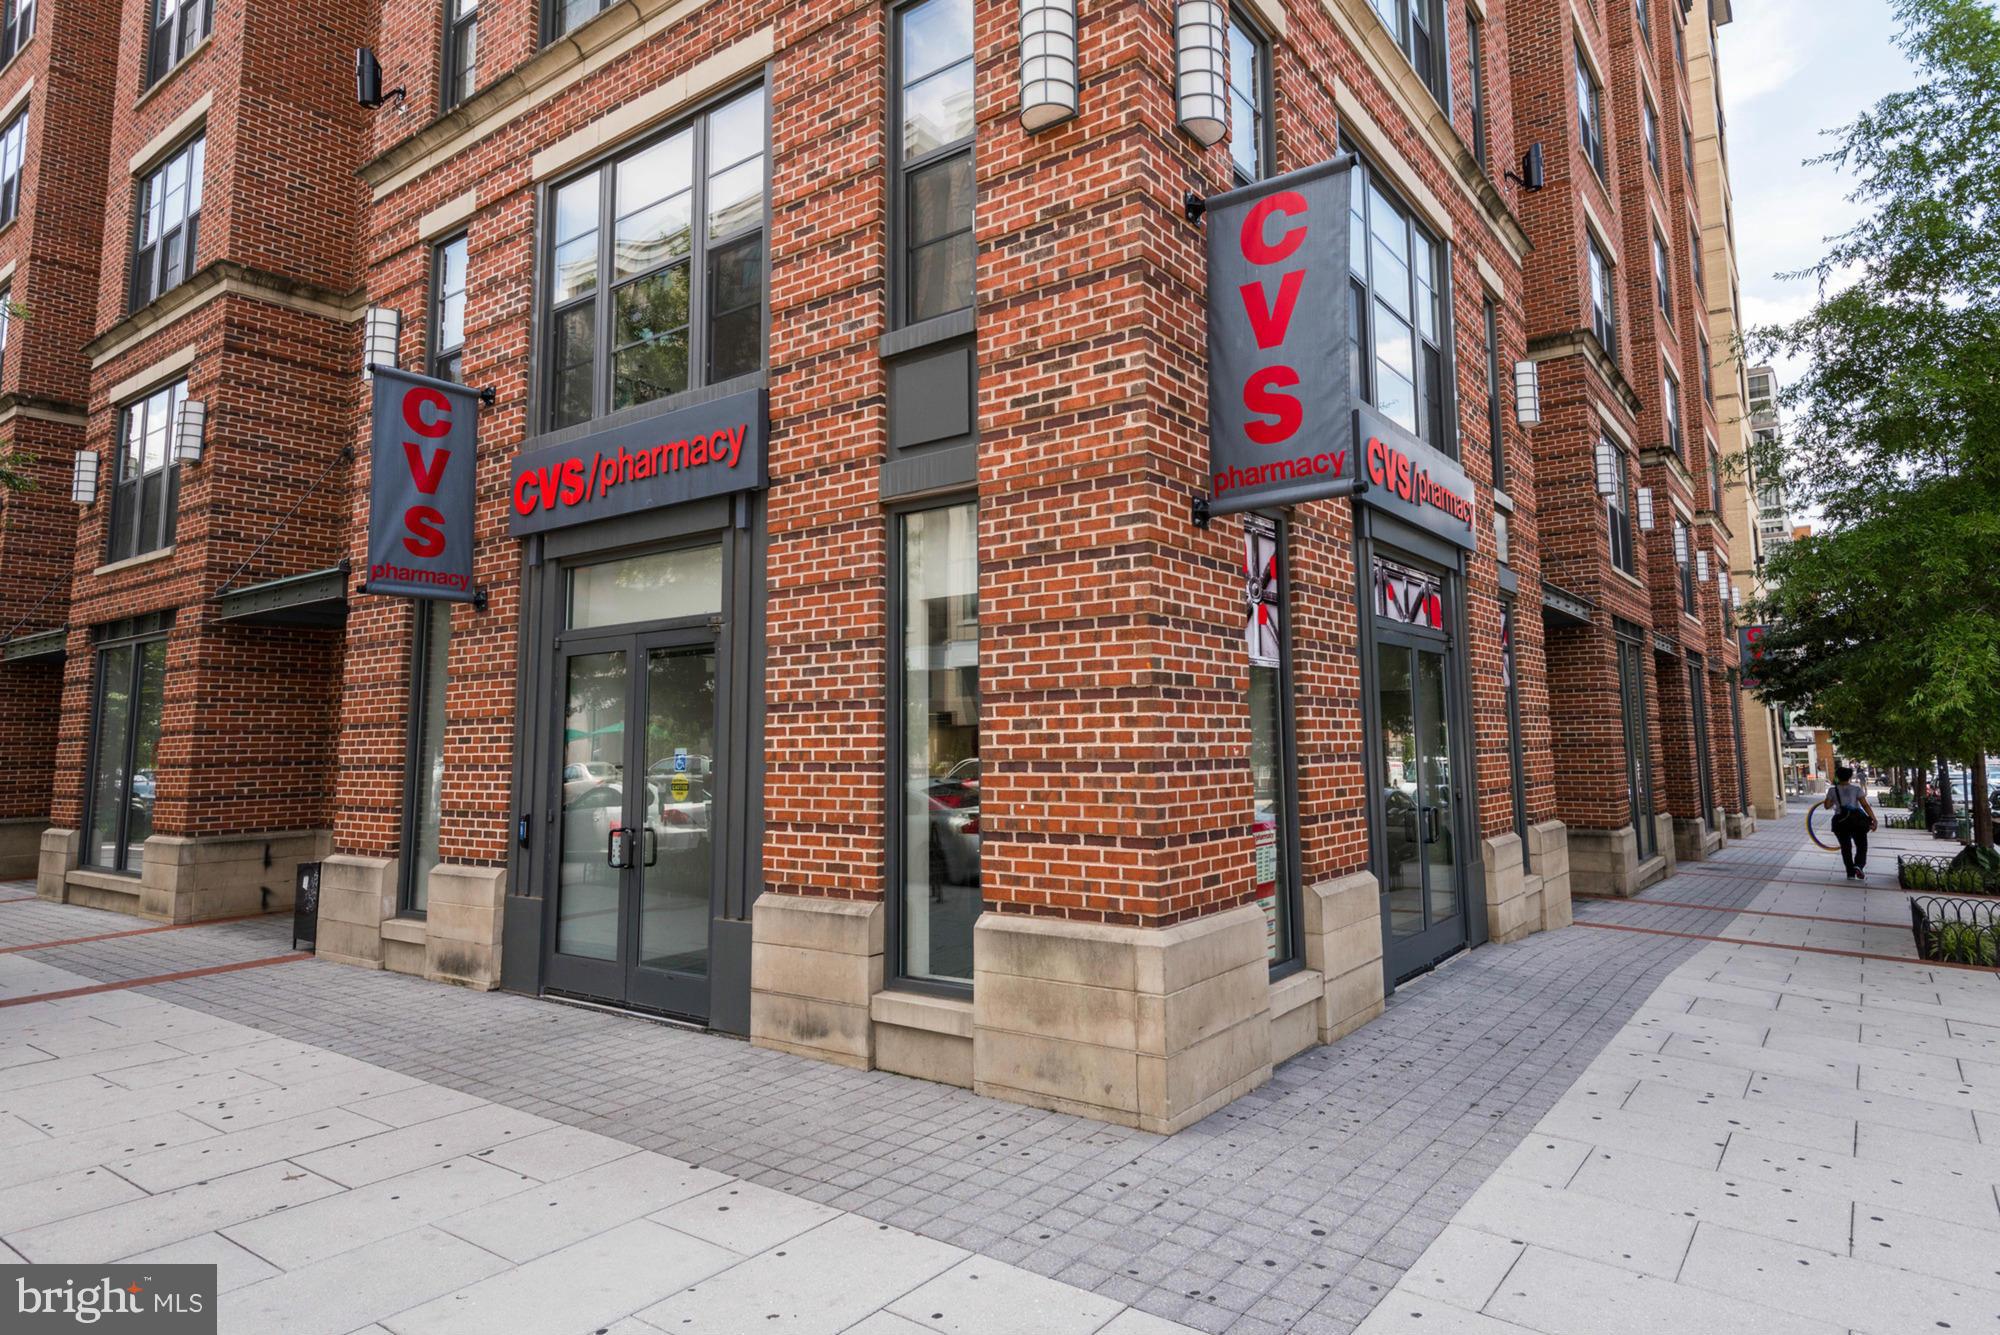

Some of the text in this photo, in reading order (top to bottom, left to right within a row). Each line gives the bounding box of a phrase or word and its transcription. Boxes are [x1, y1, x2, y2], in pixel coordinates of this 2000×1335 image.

[1239, 191, 1308, 444] CVS
[402, 387, 452, 558] CVS
[514, 424, 747, 515] CVS/pharmacy
[1214, 451, 1345, 497] pharmacy
[1367, 436, 1474, 532] CVS/pharmacy
[370, 562, 470, 591] pharmacy
